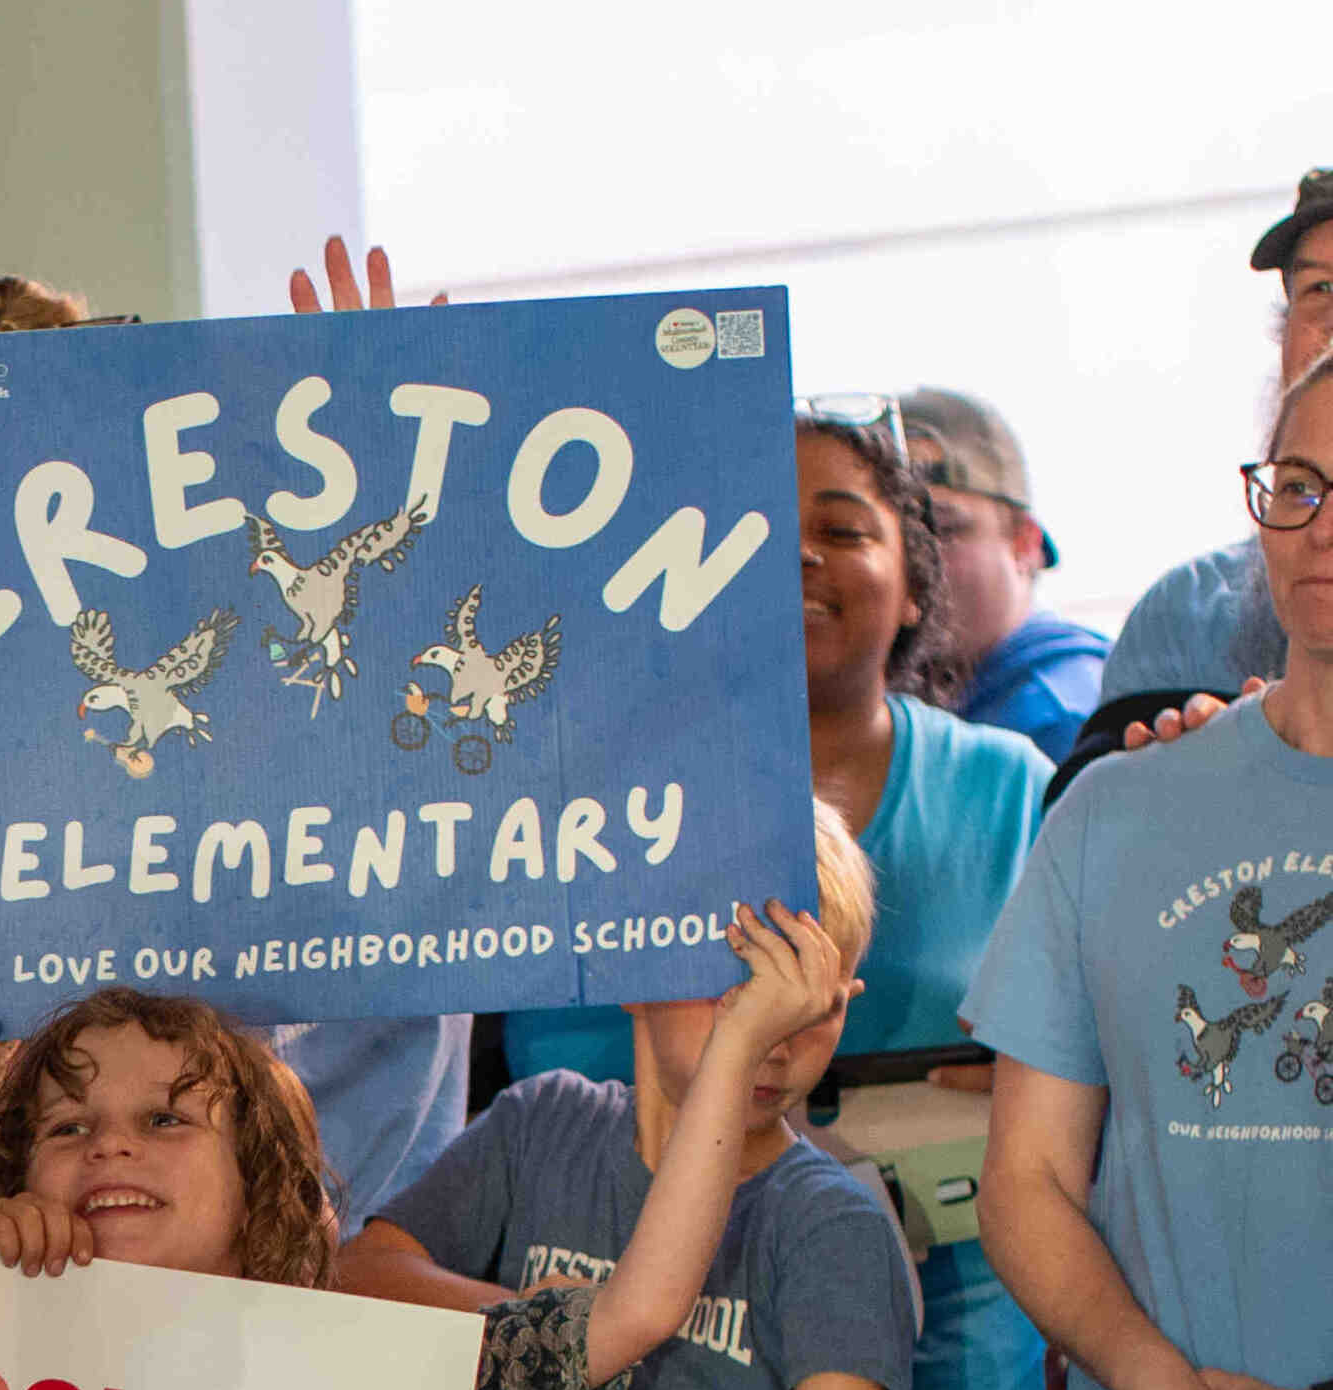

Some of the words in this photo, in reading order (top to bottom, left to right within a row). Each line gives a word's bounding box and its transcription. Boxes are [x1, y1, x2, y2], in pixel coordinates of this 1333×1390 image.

[1, 783, 683, 903] ELEMENTARY
[1158, 856, 1274, 929] CRESTON
[14, 951, 117, 985] LOVE
[134, 945, 217, 982] OUR
[236, 922, 555, 981] NEIGHBORHOOD
